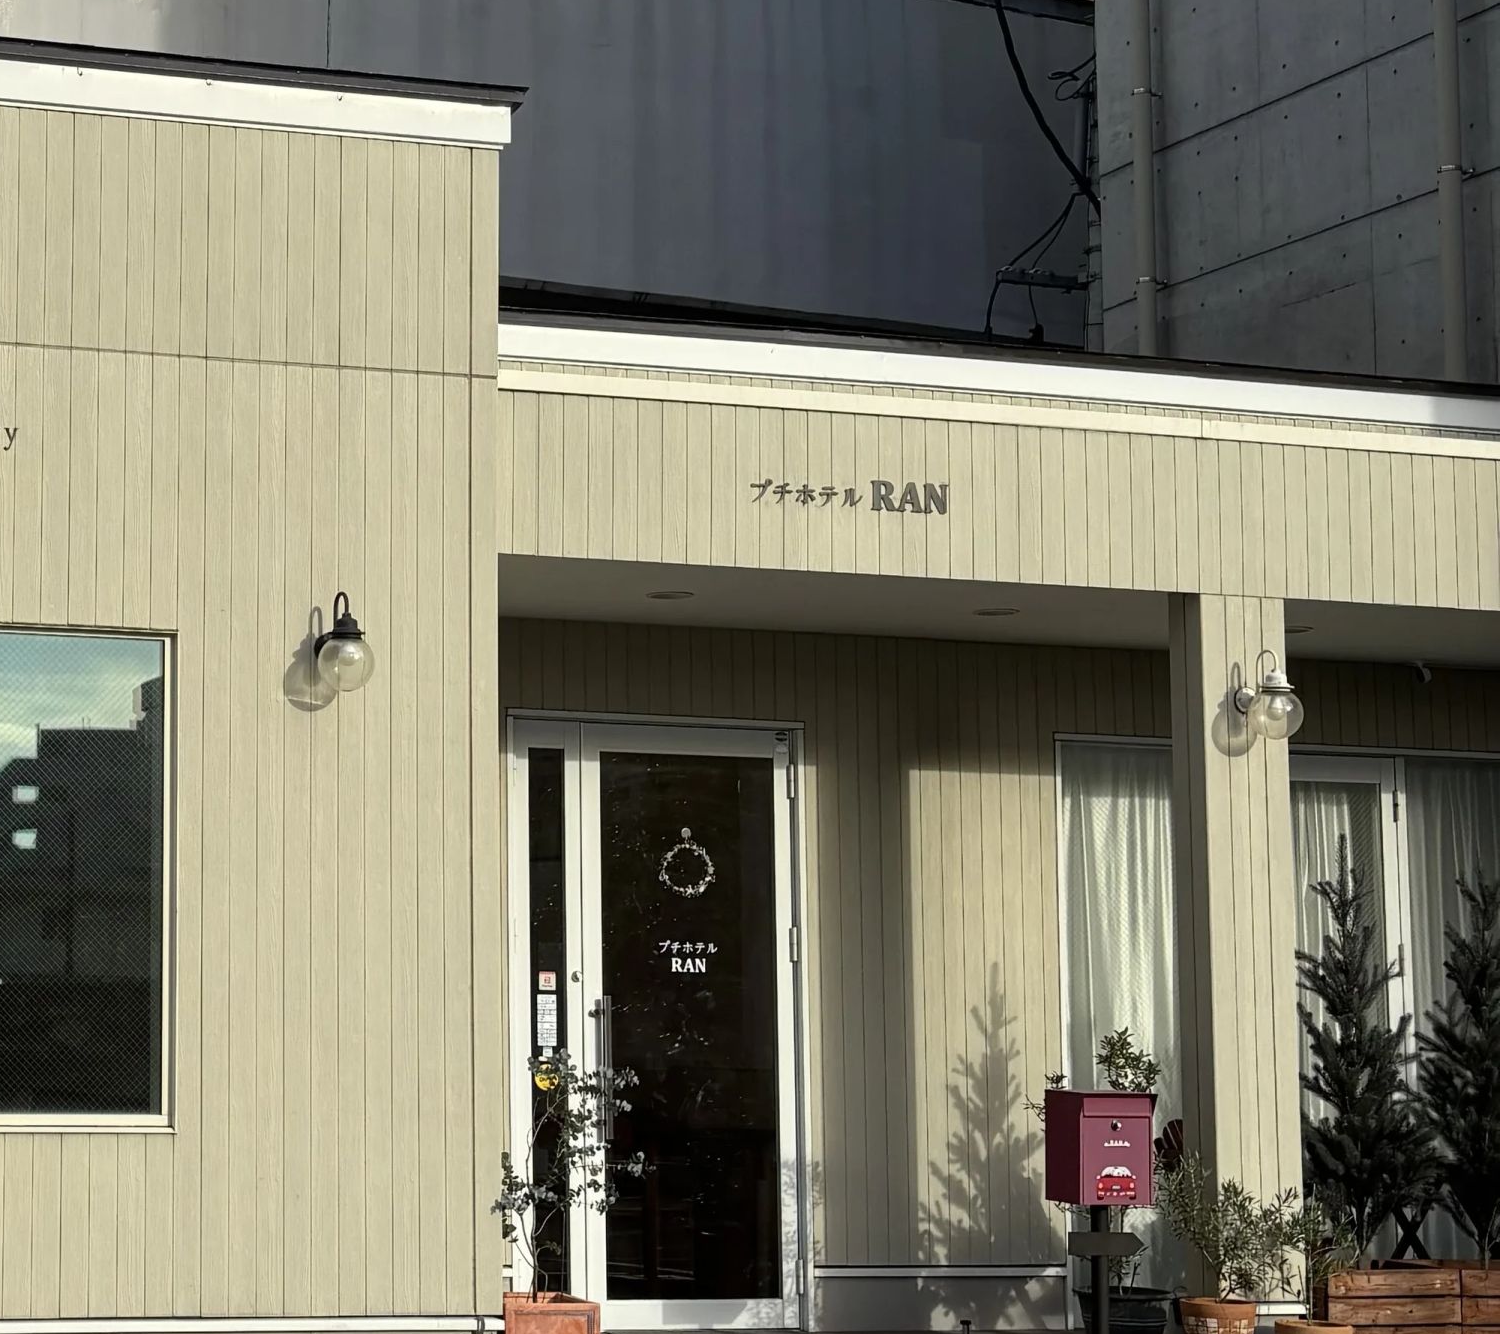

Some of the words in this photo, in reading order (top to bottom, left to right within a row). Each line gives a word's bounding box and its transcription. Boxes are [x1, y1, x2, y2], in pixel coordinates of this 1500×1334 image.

[749, 477, 863, 509] プチホテル
[870, 479, 949, 515] RAN
[658, 939, 718, 955] プチホテル
[671, 957, 707, 973] RAN
